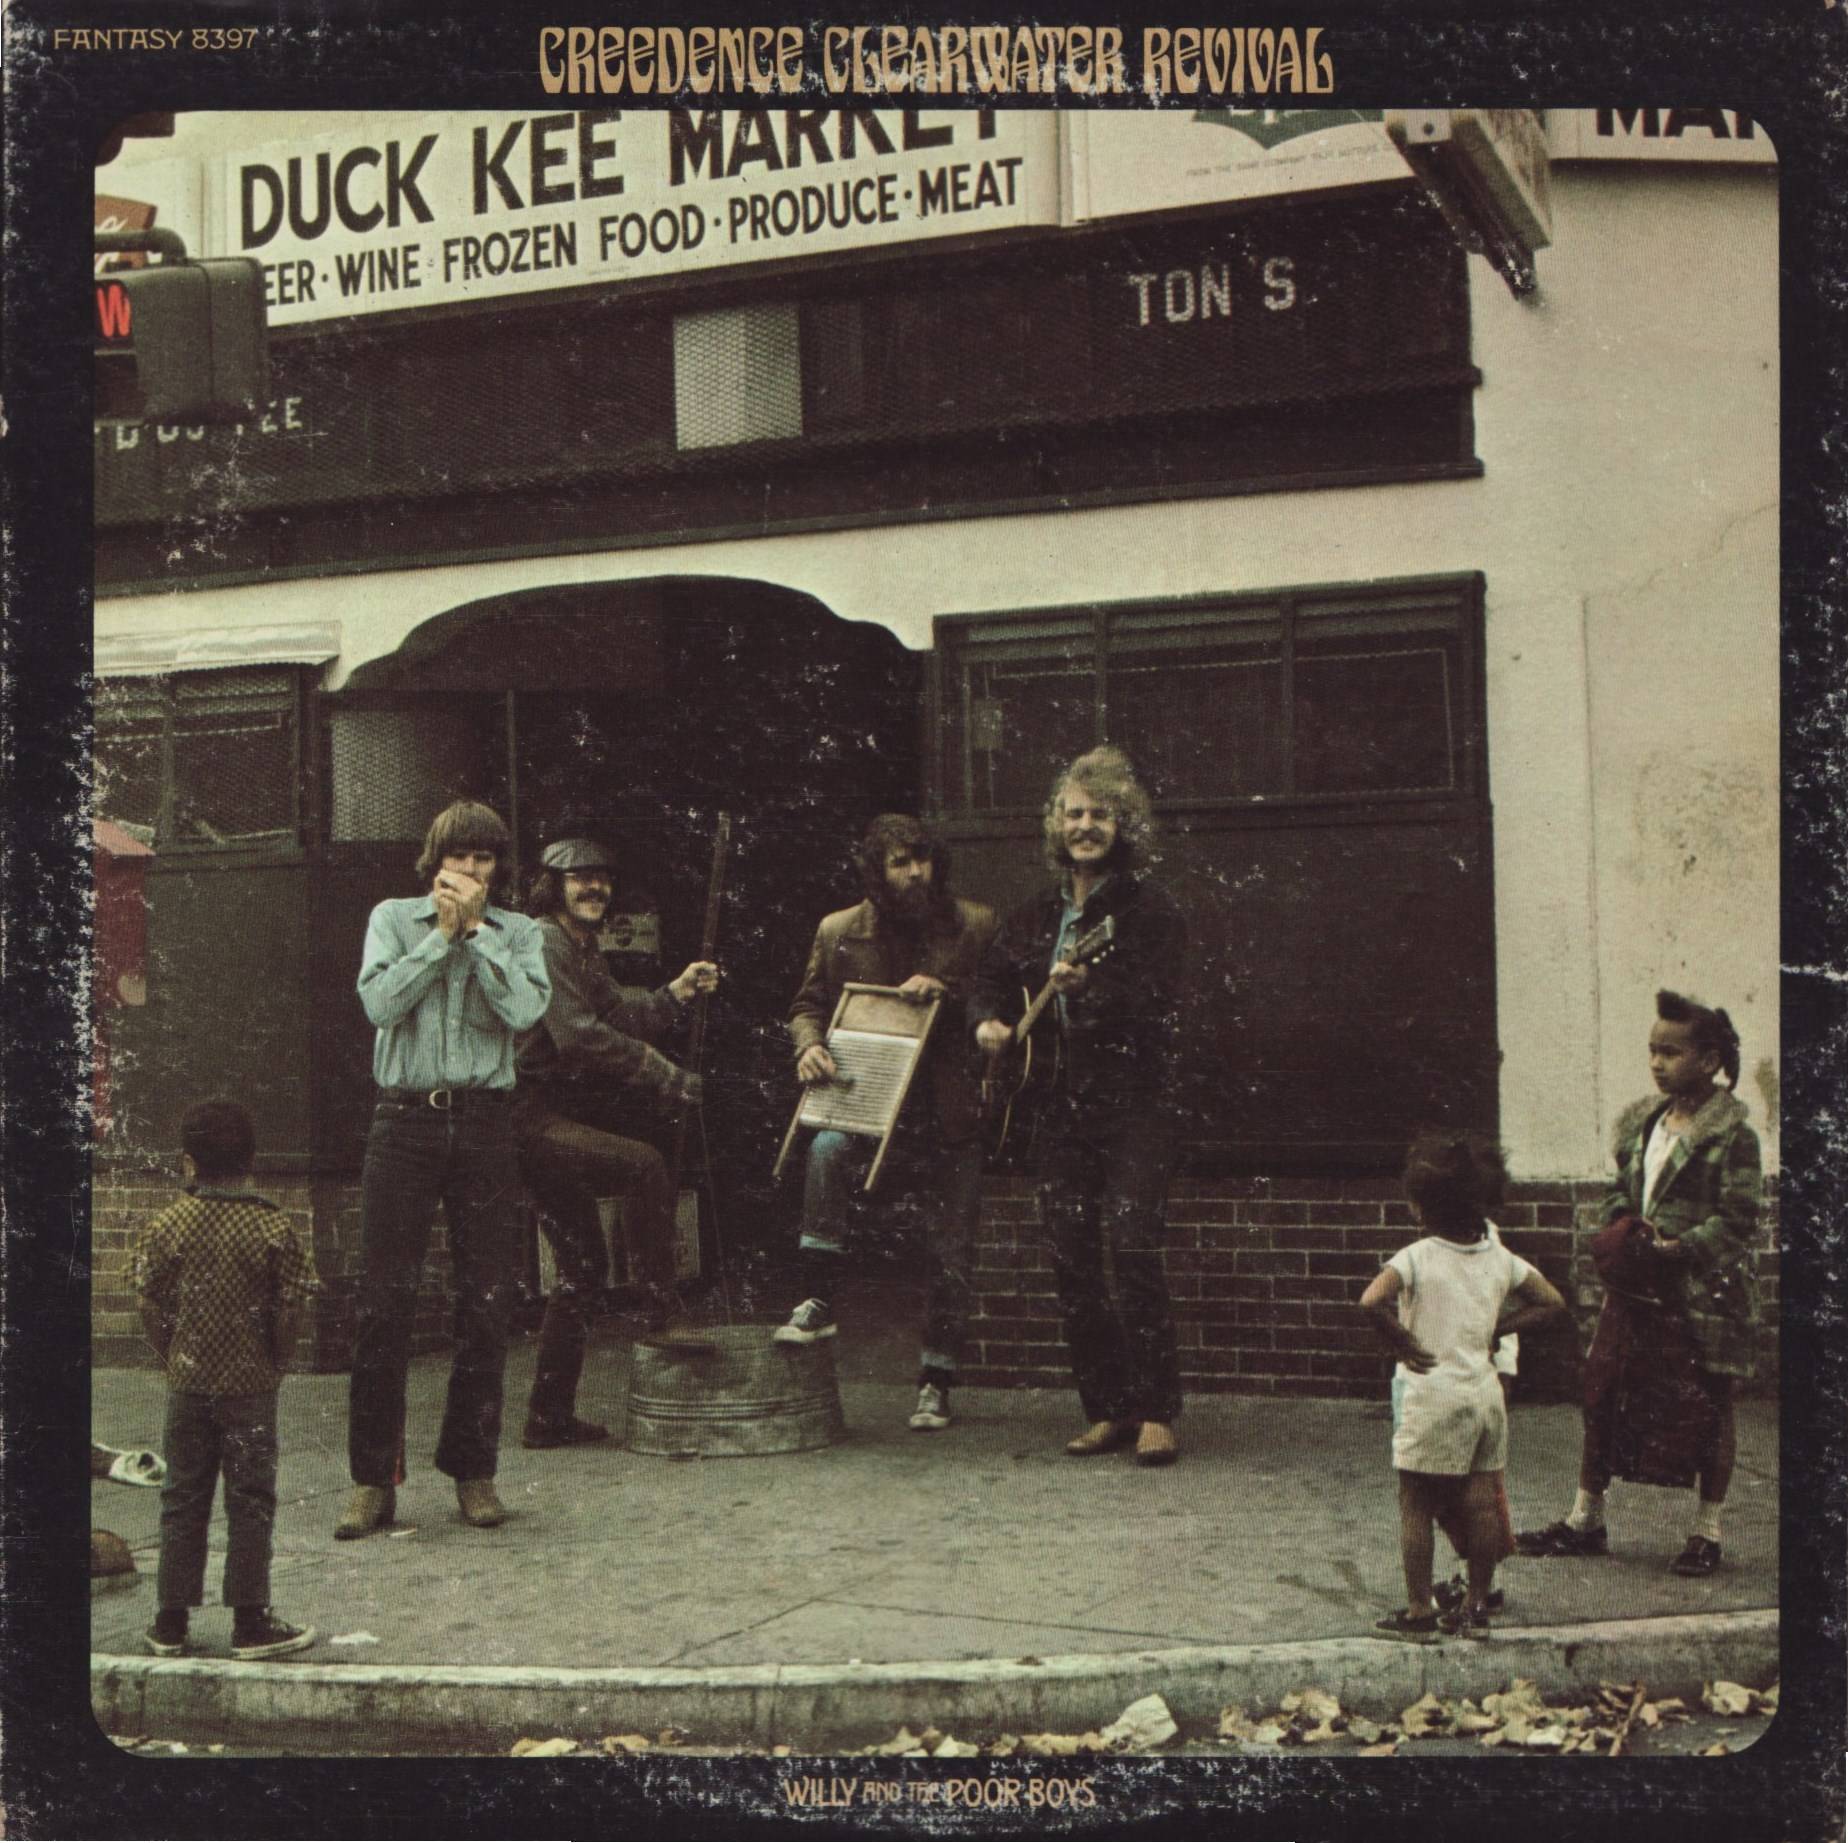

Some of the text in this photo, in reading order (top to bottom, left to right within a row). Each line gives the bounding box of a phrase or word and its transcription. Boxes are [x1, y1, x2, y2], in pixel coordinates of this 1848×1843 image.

[53, 28, 257, 50] FANTASY 8397
[539, 26, 1334, 94] CREEDENCE CLEARWATER REVIVAL
[241, 133, 440, 250] DUCK
[473, 110, 624, 216] KEE
[261, 156, 1023, 307] EER WINE FROZEN FOOD PRODUCE MEAT
[784, 1776, 857, 1807] WILLY
[862, 1780, 900, 1803] AND
[945, 1778, 1021, 1808] POOR
[1028, 1777, 1096, 1808] BOYS
